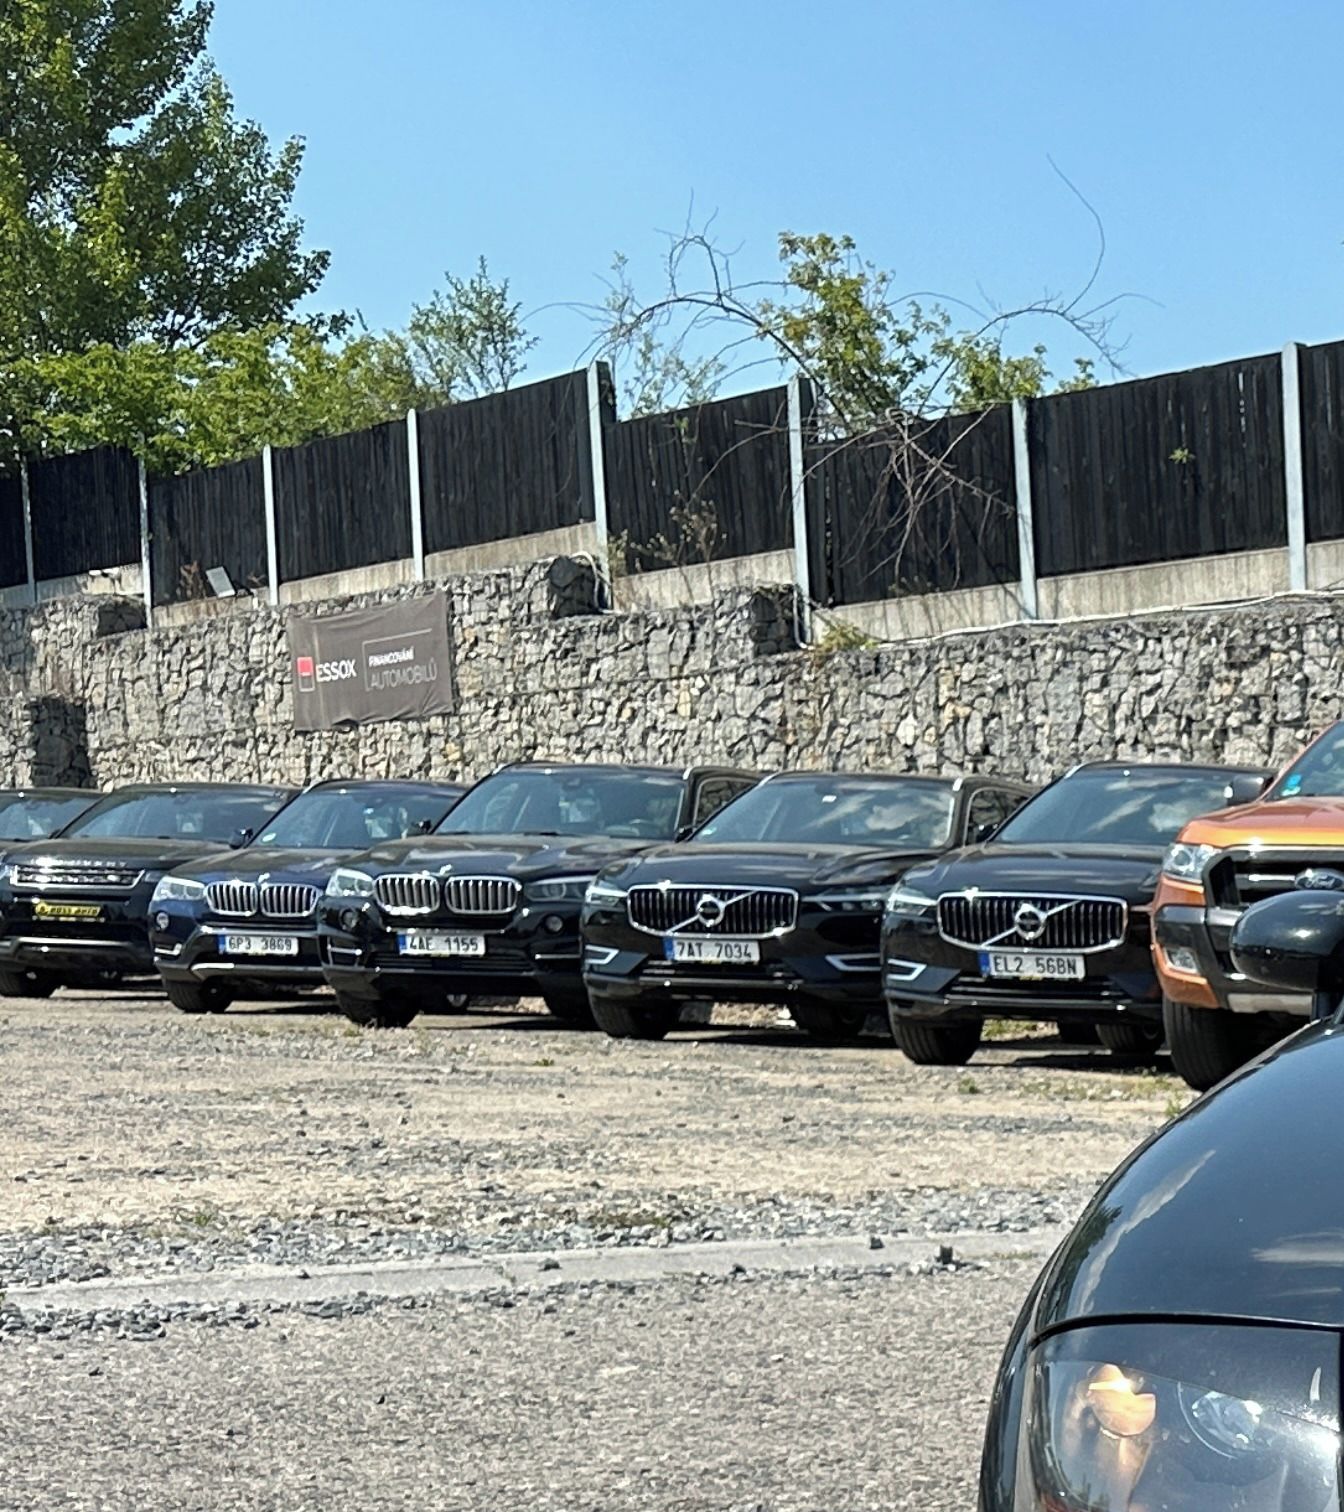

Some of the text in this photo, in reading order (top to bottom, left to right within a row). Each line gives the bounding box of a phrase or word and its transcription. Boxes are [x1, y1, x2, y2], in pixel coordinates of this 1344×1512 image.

[315, 659, 357, 683] ESSOX
[676, 942, 751, 959] 7AT 7034
[993, 956, 1077, 975] EL2 56BN
